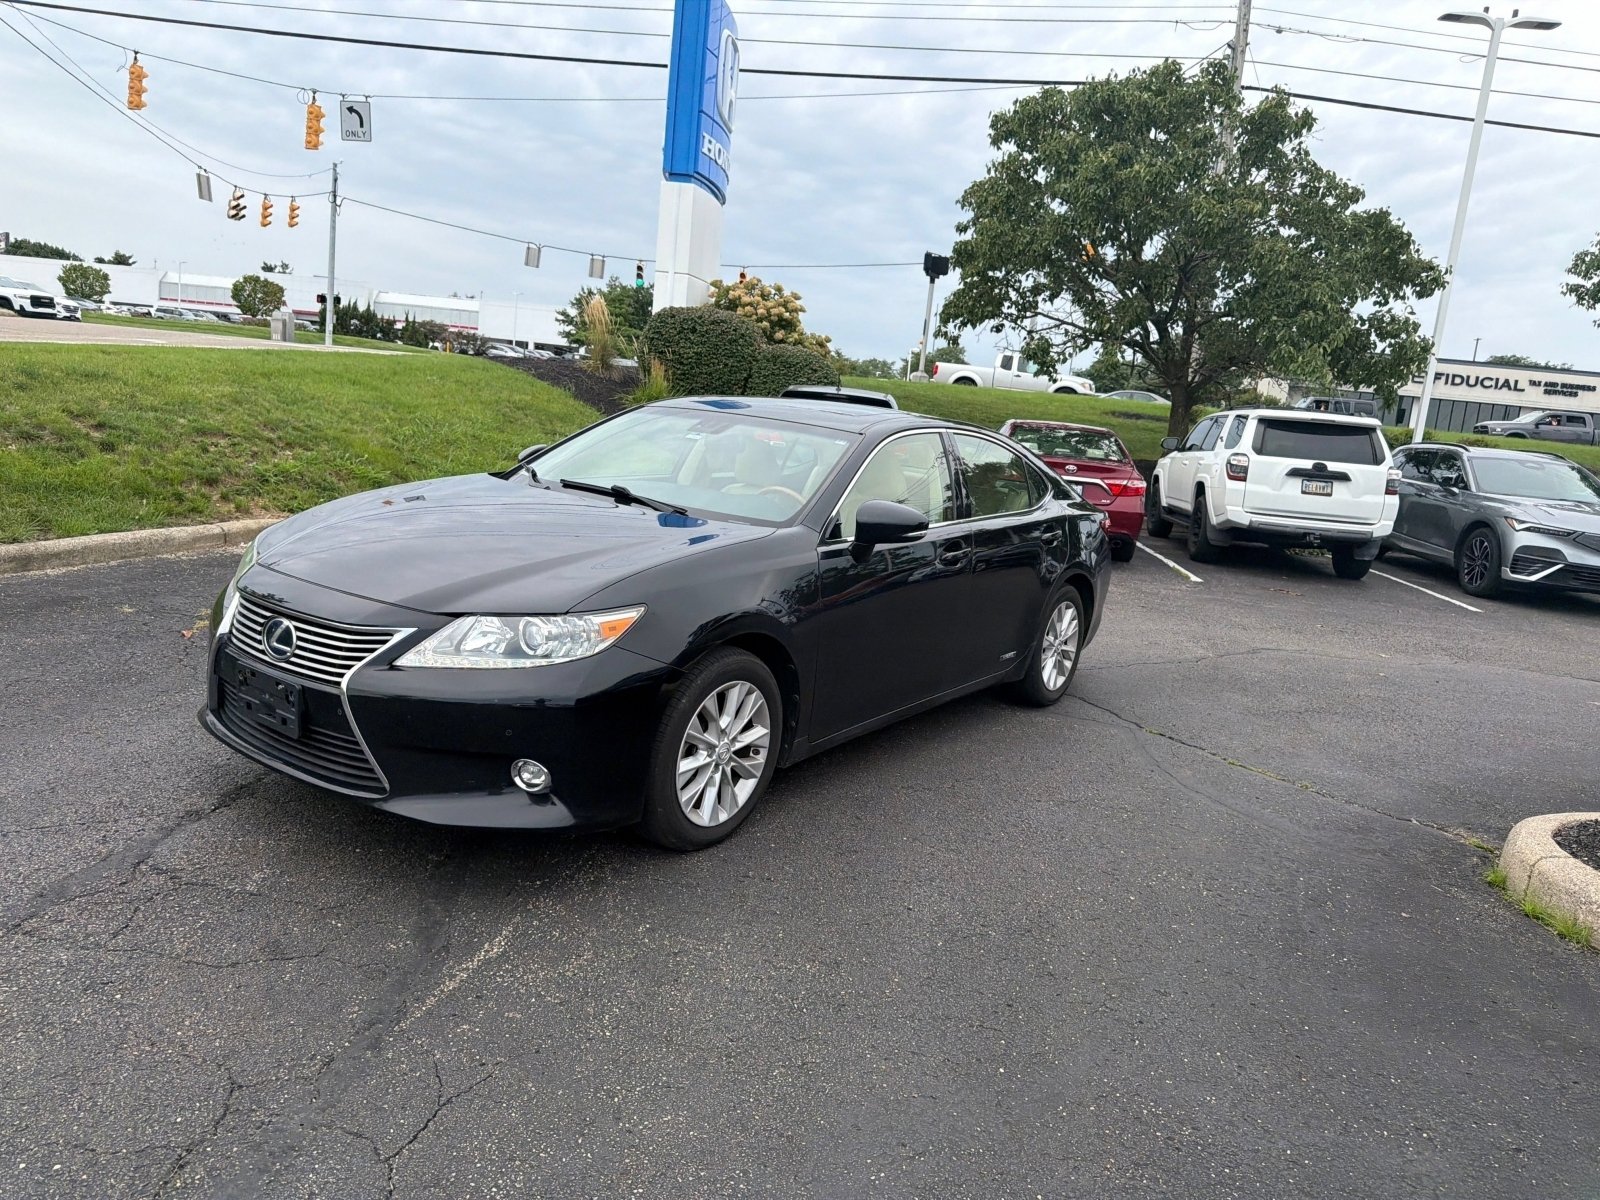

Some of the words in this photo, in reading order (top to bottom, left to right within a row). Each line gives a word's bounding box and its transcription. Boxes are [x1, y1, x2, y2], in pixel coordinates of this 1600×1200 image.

[345, 129, 367, 139] ONLY
[1433, 372, 1525, 392] FIDUCIAL
[1528, 379, 1542, 387] TAX
